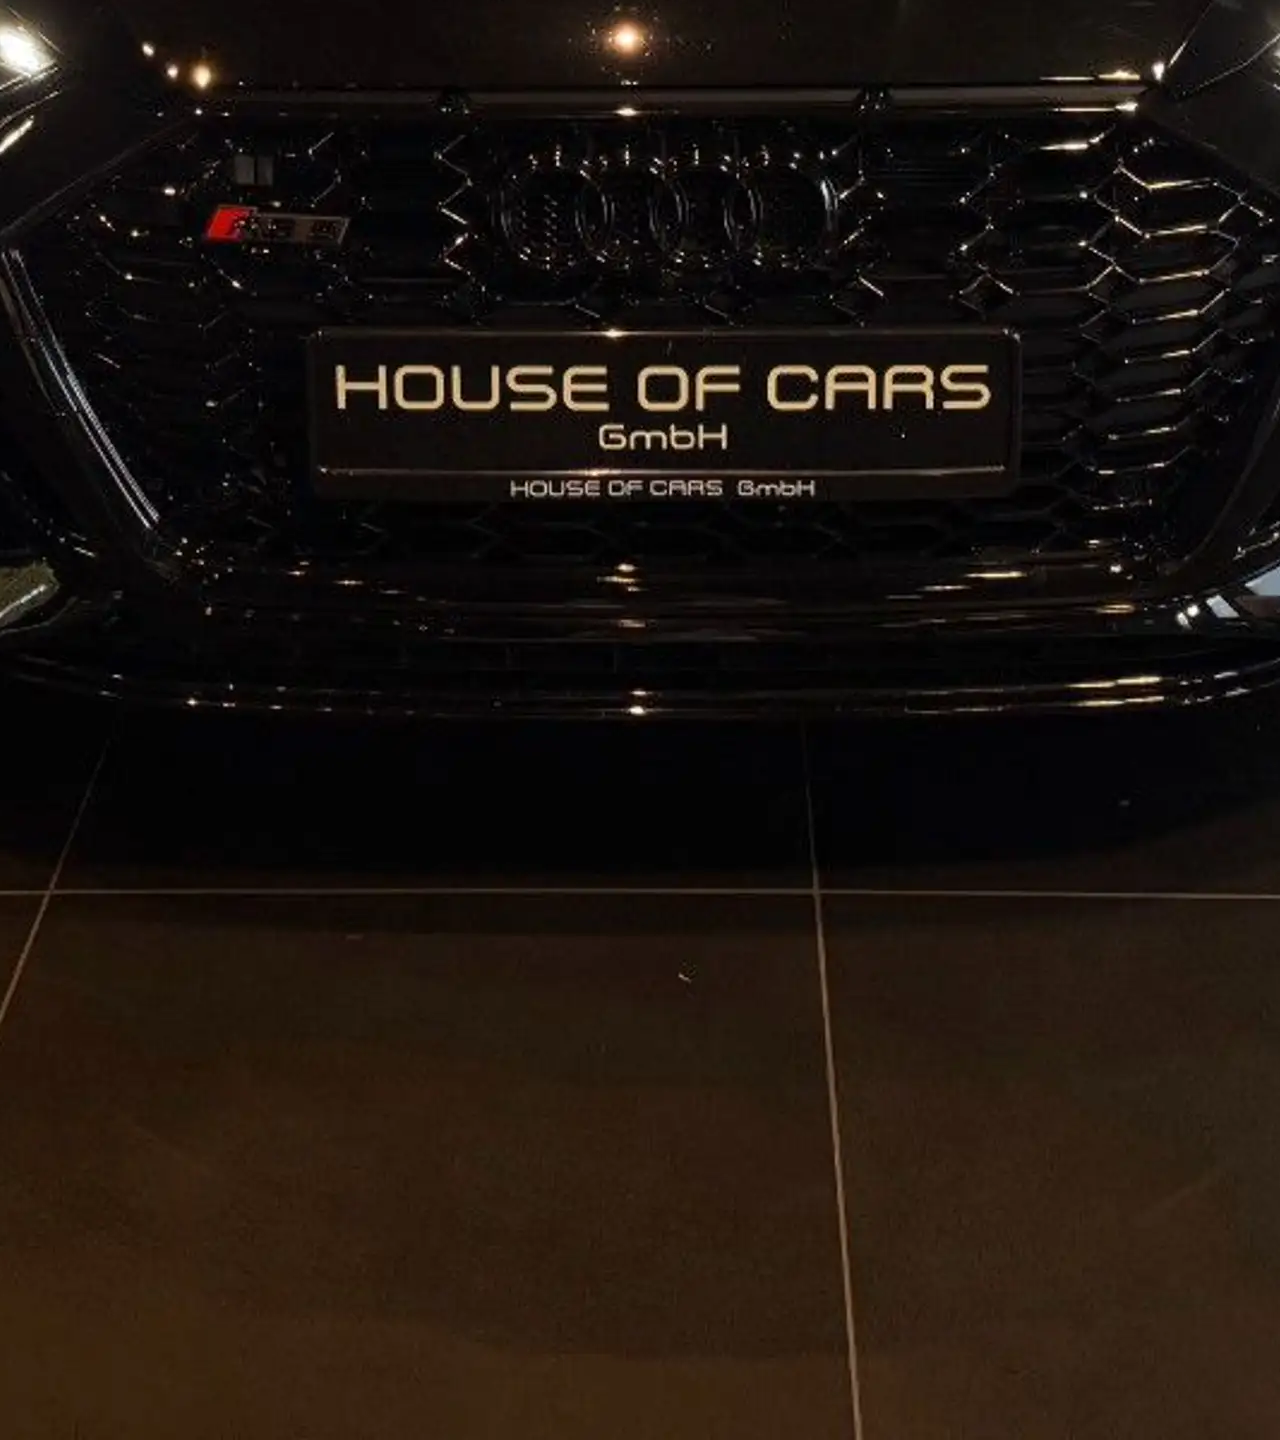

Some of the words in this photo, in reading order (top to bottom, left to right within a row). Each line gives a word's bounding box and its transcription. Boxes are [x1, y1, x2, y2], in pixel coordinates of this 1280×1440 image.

[335, 364, 610, 412] HOUSE
[637, 364, 741, 412] OF
[766, 364, 992, 412] CARS
[598, 422, 728, 451] GmbH
[510, 479, 601, 498] HOUSE
[607, 479, 644, 498] OF
[649, 479, 723, 498] CARS
[736, 479, 816, 498] GmbH
